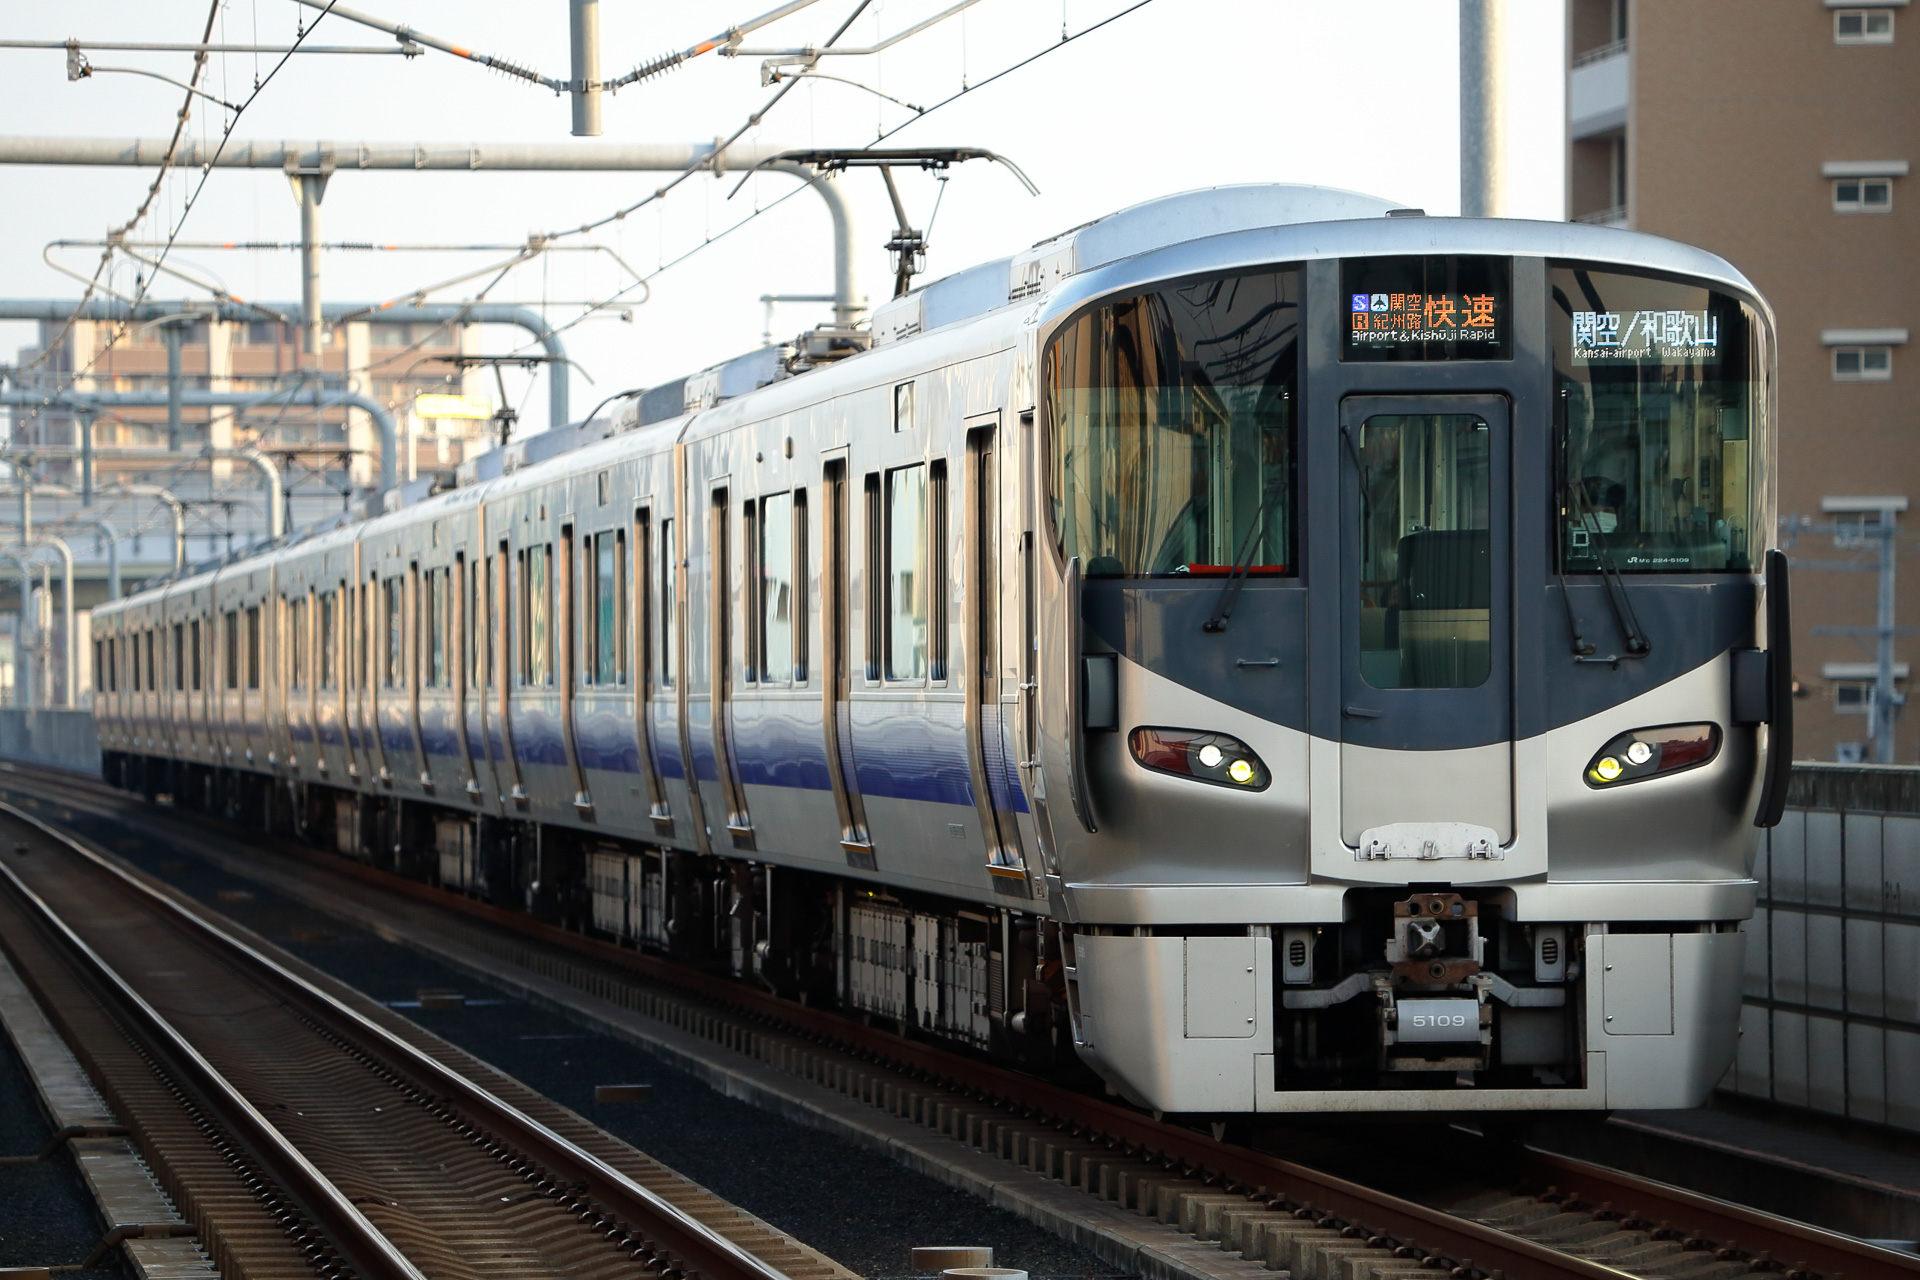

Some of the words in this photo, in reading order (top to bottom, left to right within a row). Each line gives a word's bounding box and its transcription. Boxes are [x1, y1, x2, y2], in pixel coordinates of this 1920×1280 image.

[1390, 293, 1422, 311] 関空
[1424, 294, 1495, 328] 快速
[1373, 313, 1422, 329] 紀州路
[1352, 330, 1398, 342] Airport
[1399, 331, 1410, 342] &
[1460, 329, 1495, 341] Rapid
[1574, 347, 1652, 359] Kansai-airport
[1662, 347, 1716, 358] Wakayama
[1413, 1015, 1465, 1027] 5109
